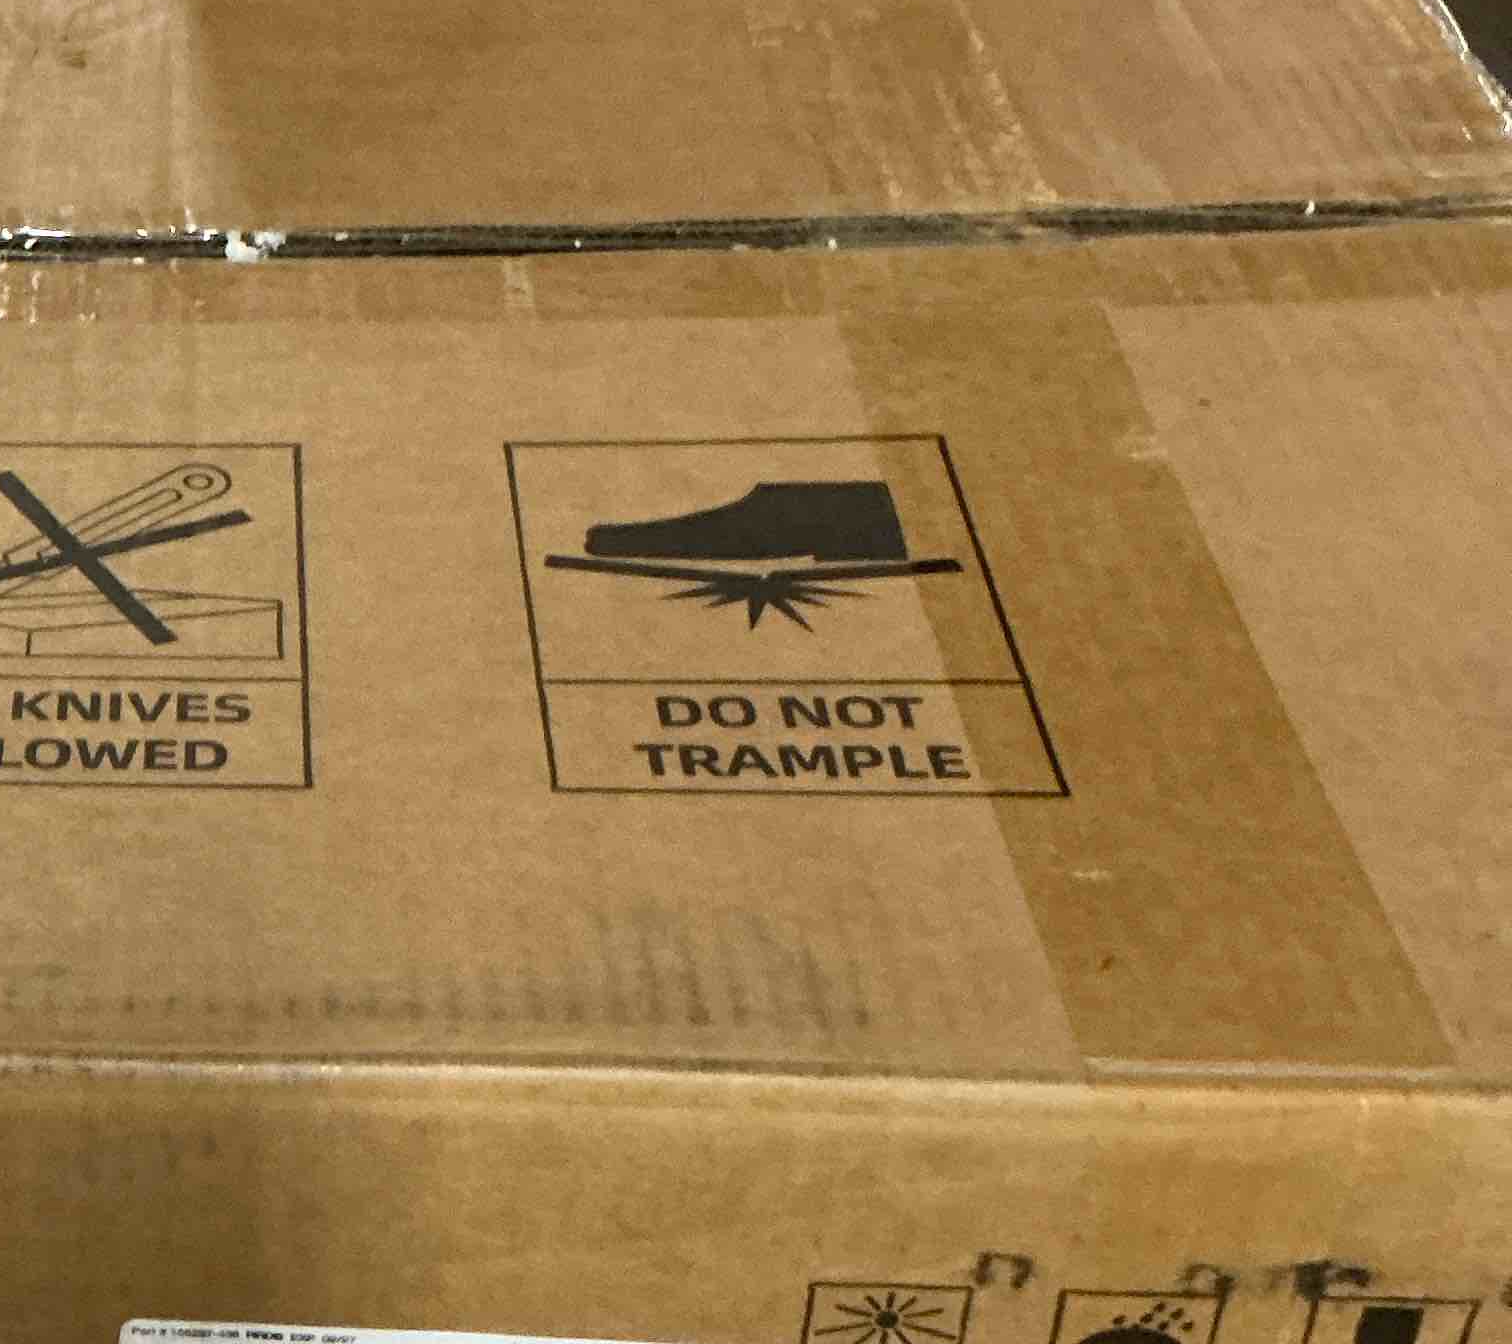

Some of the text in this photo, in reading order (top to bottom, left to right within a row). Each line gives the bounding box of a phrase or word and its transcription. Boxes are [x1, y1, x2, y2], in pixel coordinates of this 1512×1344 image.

[11, 692, 252, 723] KNIVES
[655, 696, 923, 730] DO NOT
[634, 743, 971, 779] TRAMPLE
